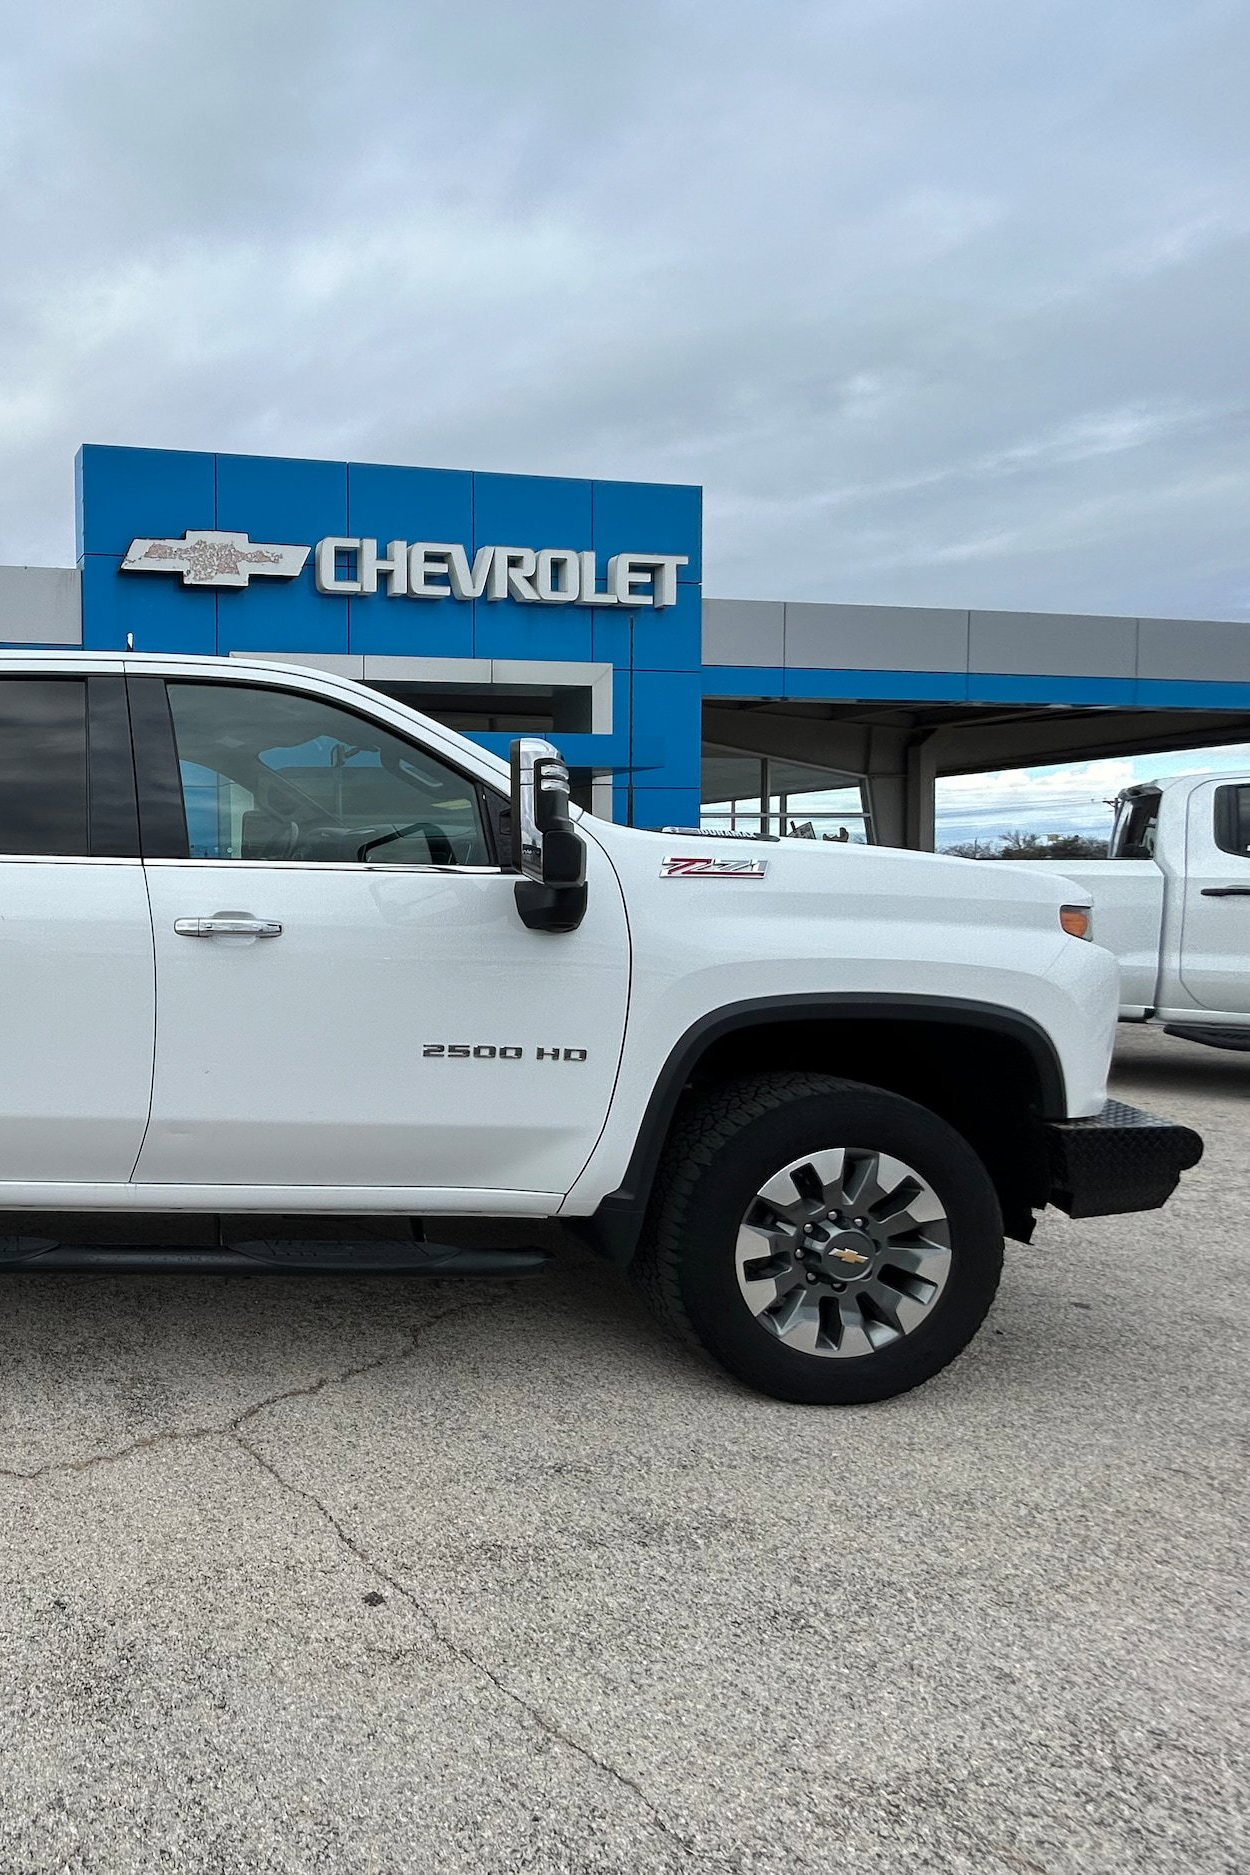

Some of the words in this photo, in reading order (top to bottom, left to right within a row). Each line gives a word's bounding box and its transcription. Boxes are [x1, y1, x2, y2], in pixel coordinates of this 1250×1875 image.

[315, 537, 689, 608] CHEVROLET
[659, 856, 768, 879] Z71
[422, 1044, 523, 1059] 2500
[536, 1047, 587, 1061] HD
